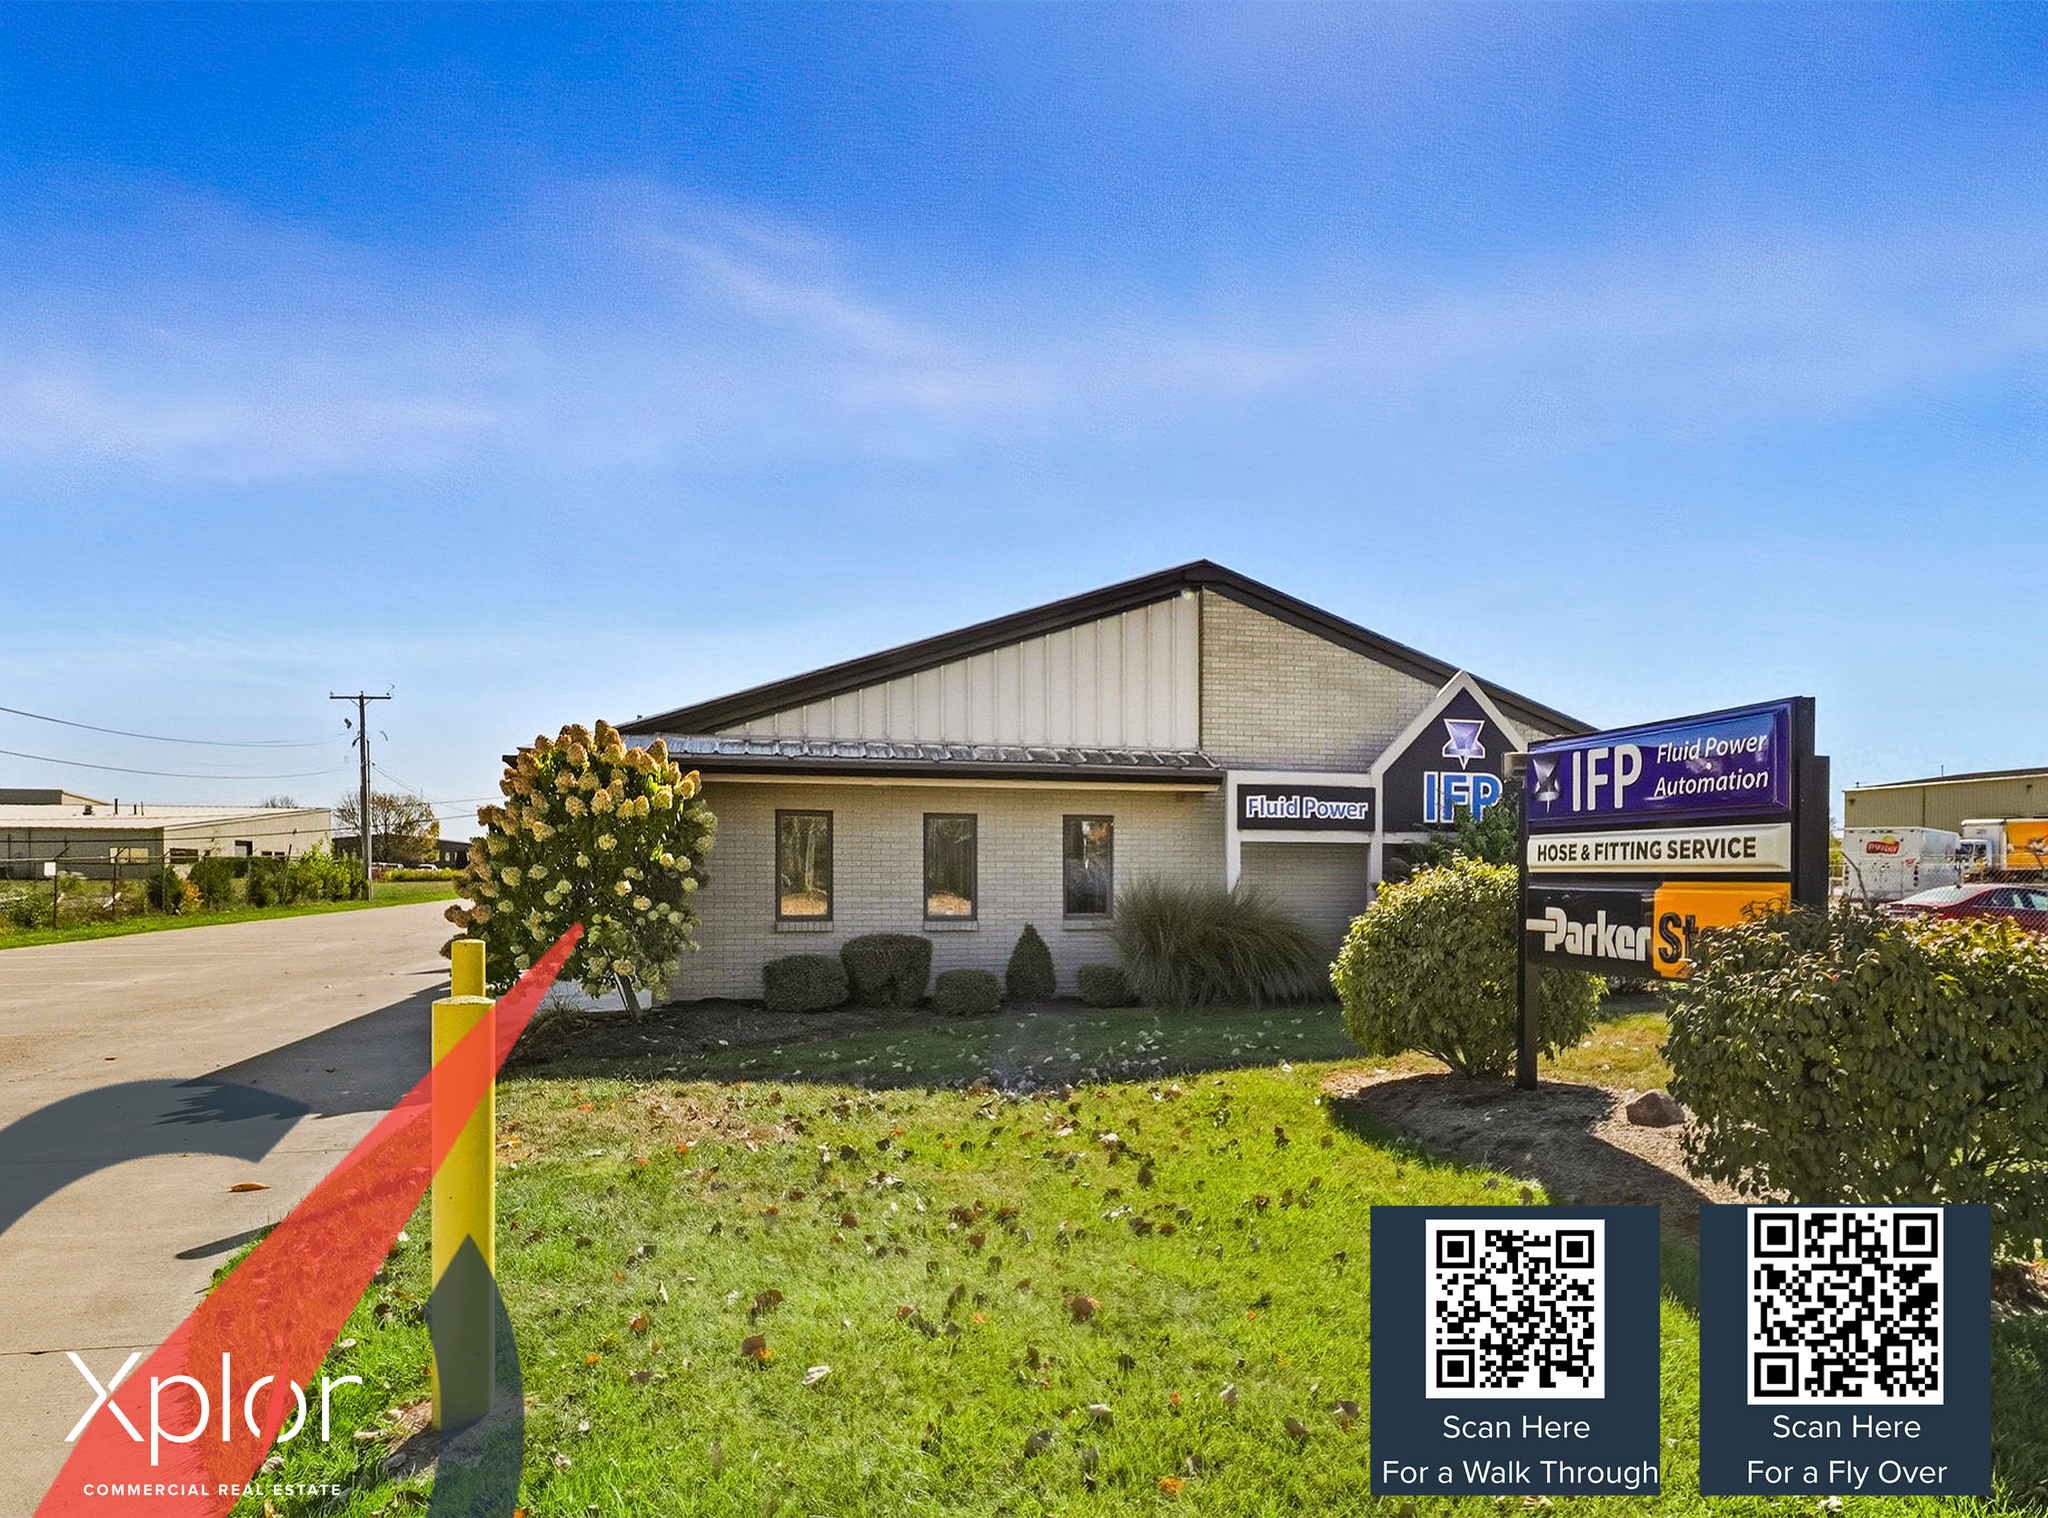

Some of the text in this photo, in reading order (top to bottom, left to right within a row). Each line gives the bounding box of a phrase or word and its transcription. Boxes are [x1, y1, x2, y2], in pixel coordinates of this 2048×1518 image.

[1657, 734, 1767, 763] Fluid Power
[1572, 744, 1643, 812] IFP
[1654, 769, 1769, 797] Automation
[1246, 795, 1368, 819] Fluid Power
[1423, 771, 1503, 824] IFP
[1538, 836, 1757, 861] HOSE & FITTING SERVICE
[1527, 907, 1651, 961] Parker
